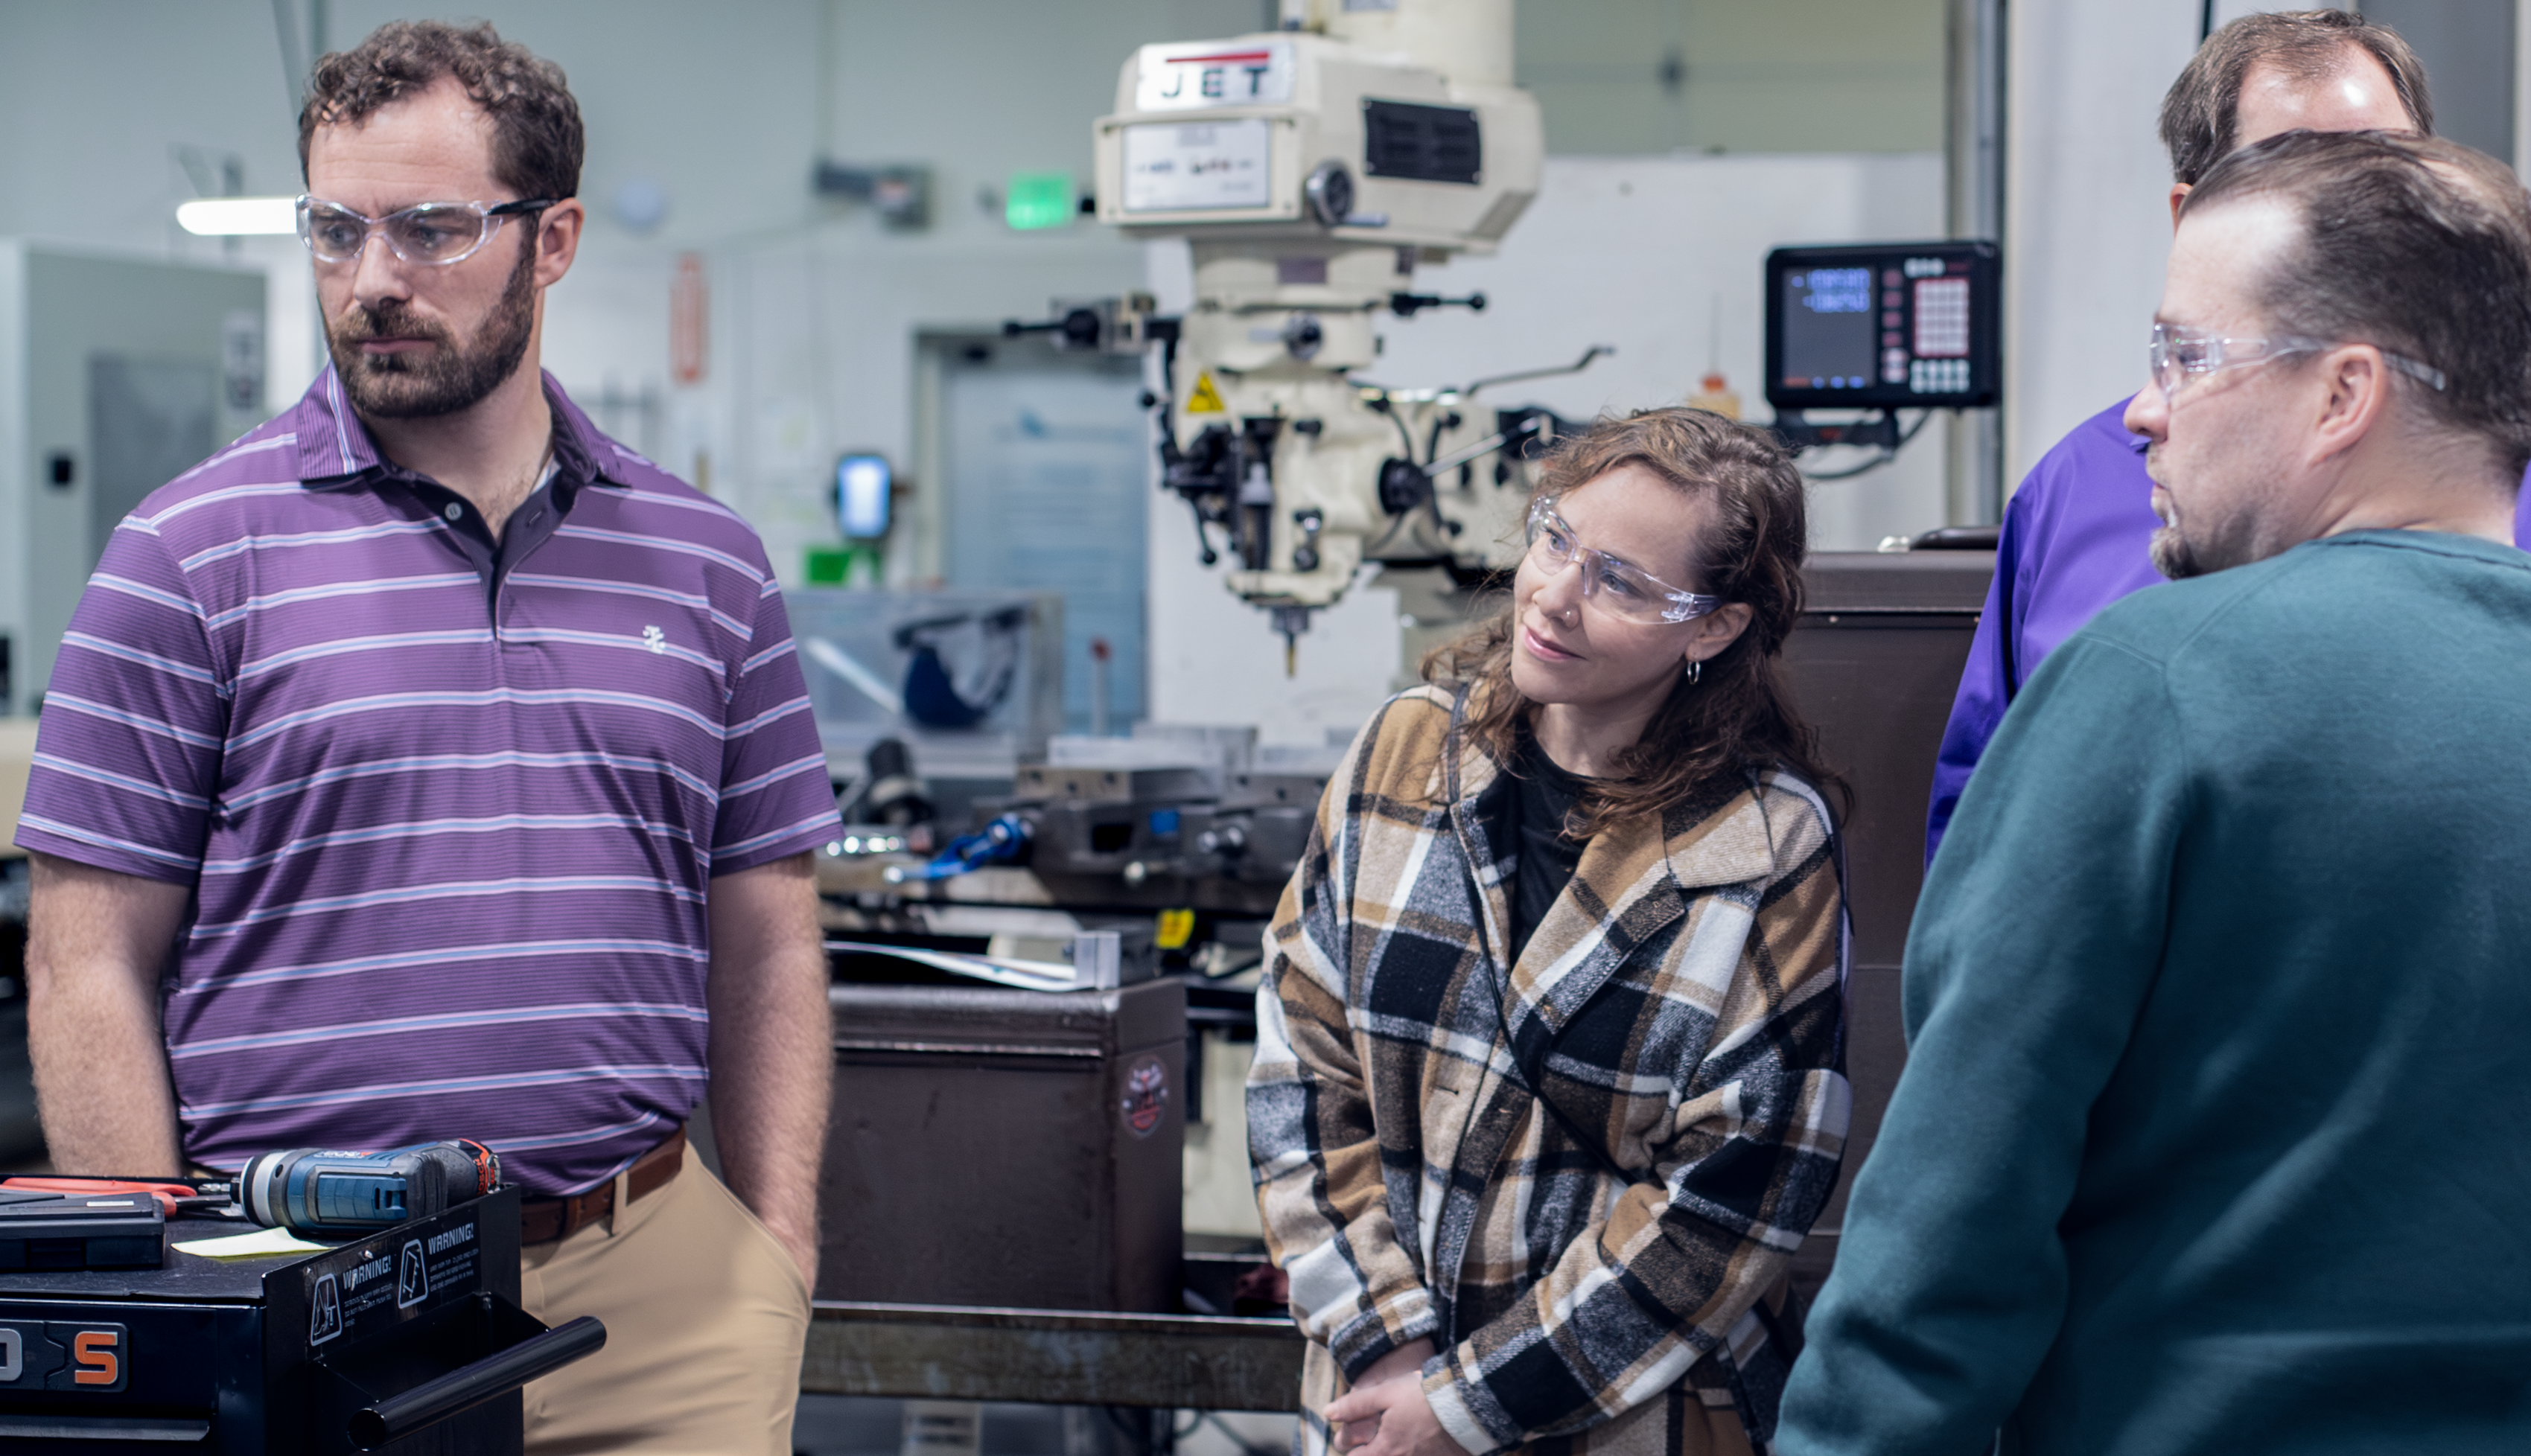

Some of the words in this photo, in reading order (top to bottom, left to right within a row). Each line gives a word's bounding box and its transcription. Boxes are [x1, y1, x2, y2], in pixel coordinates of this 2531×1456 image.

[1161, 66, 1269, 98] JET
[428, 1222, 474, 1254] WARNING!
[343, 1255, 392, 1286] WARNING!
